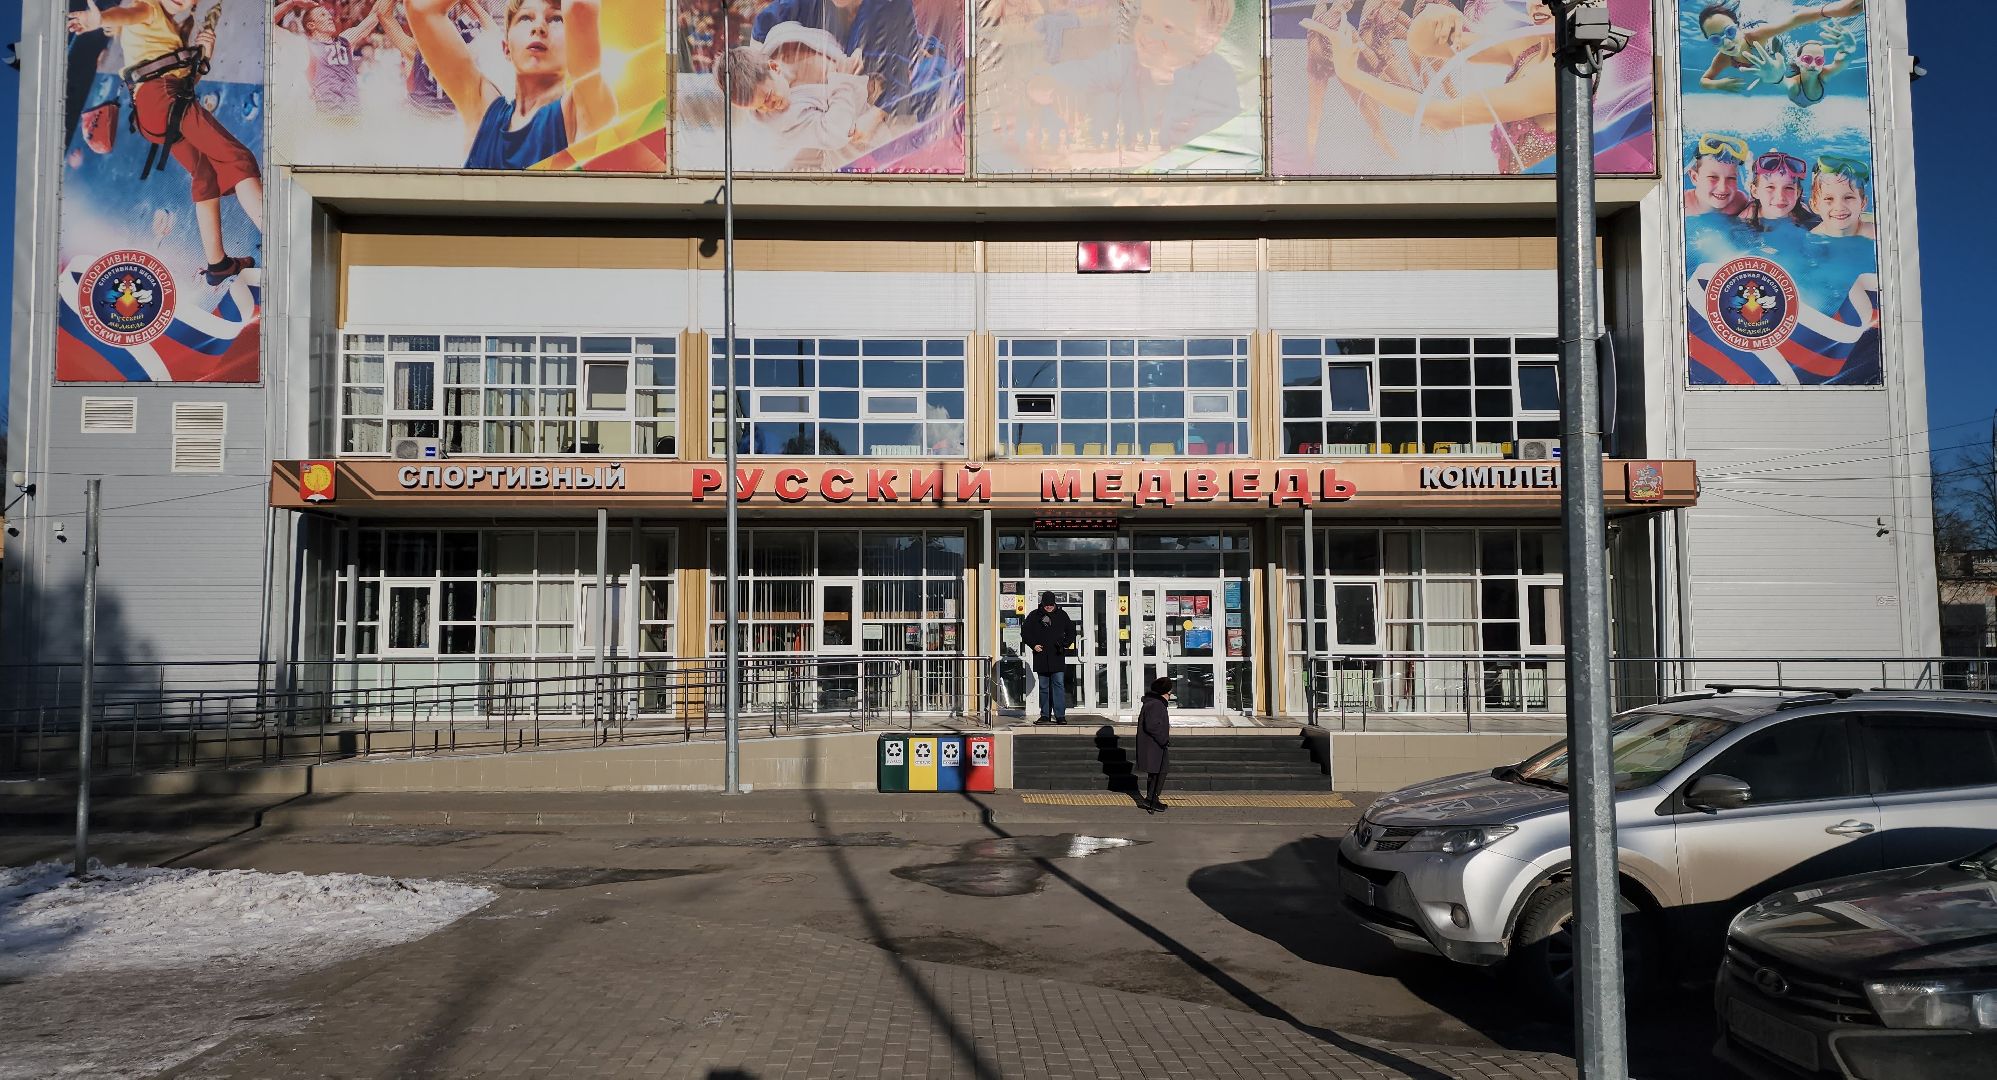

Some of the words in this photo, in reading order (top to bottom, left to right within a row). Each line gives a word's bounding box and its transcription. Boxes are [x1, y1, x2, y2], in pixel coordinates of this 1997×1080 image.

[327, 43, 349, 66] 20
[82, 253, 146, 294] СПОРТИВНАЯ
[148, 259, 173, 295] ШКОЛА
[98, 265, 138, 286] СПОРТИВНАЯ
[139, 268, 157, 287] ШКОЛА
[1709, 260, 1767, 301] СПОРТИВНАЯ
[1769, 267, 1794, 301] ШКОЛА
[1724, 273, 1760, 293] СПОРТИВНАЯ
[1761, 275, 1779, 293] ШКОЛА
[82, 305, 122, 343] РУССКИЙ
[126, 309, 171, 343] МЕДВЕДЬ
[1709, 311, 1749, 348] РУССКИЙ
[1752, 314, 1795, 348] МЕДВЕДЬ
[398, 462, 626, 488] СПОРТИВНЫЙ
[692, 462, 992, 501] РУССКИЙ
[1042, 468, 1357, 507] МЕДВЕДЬ
[1421, 466, 1561, 489] КОМПЛЕ
